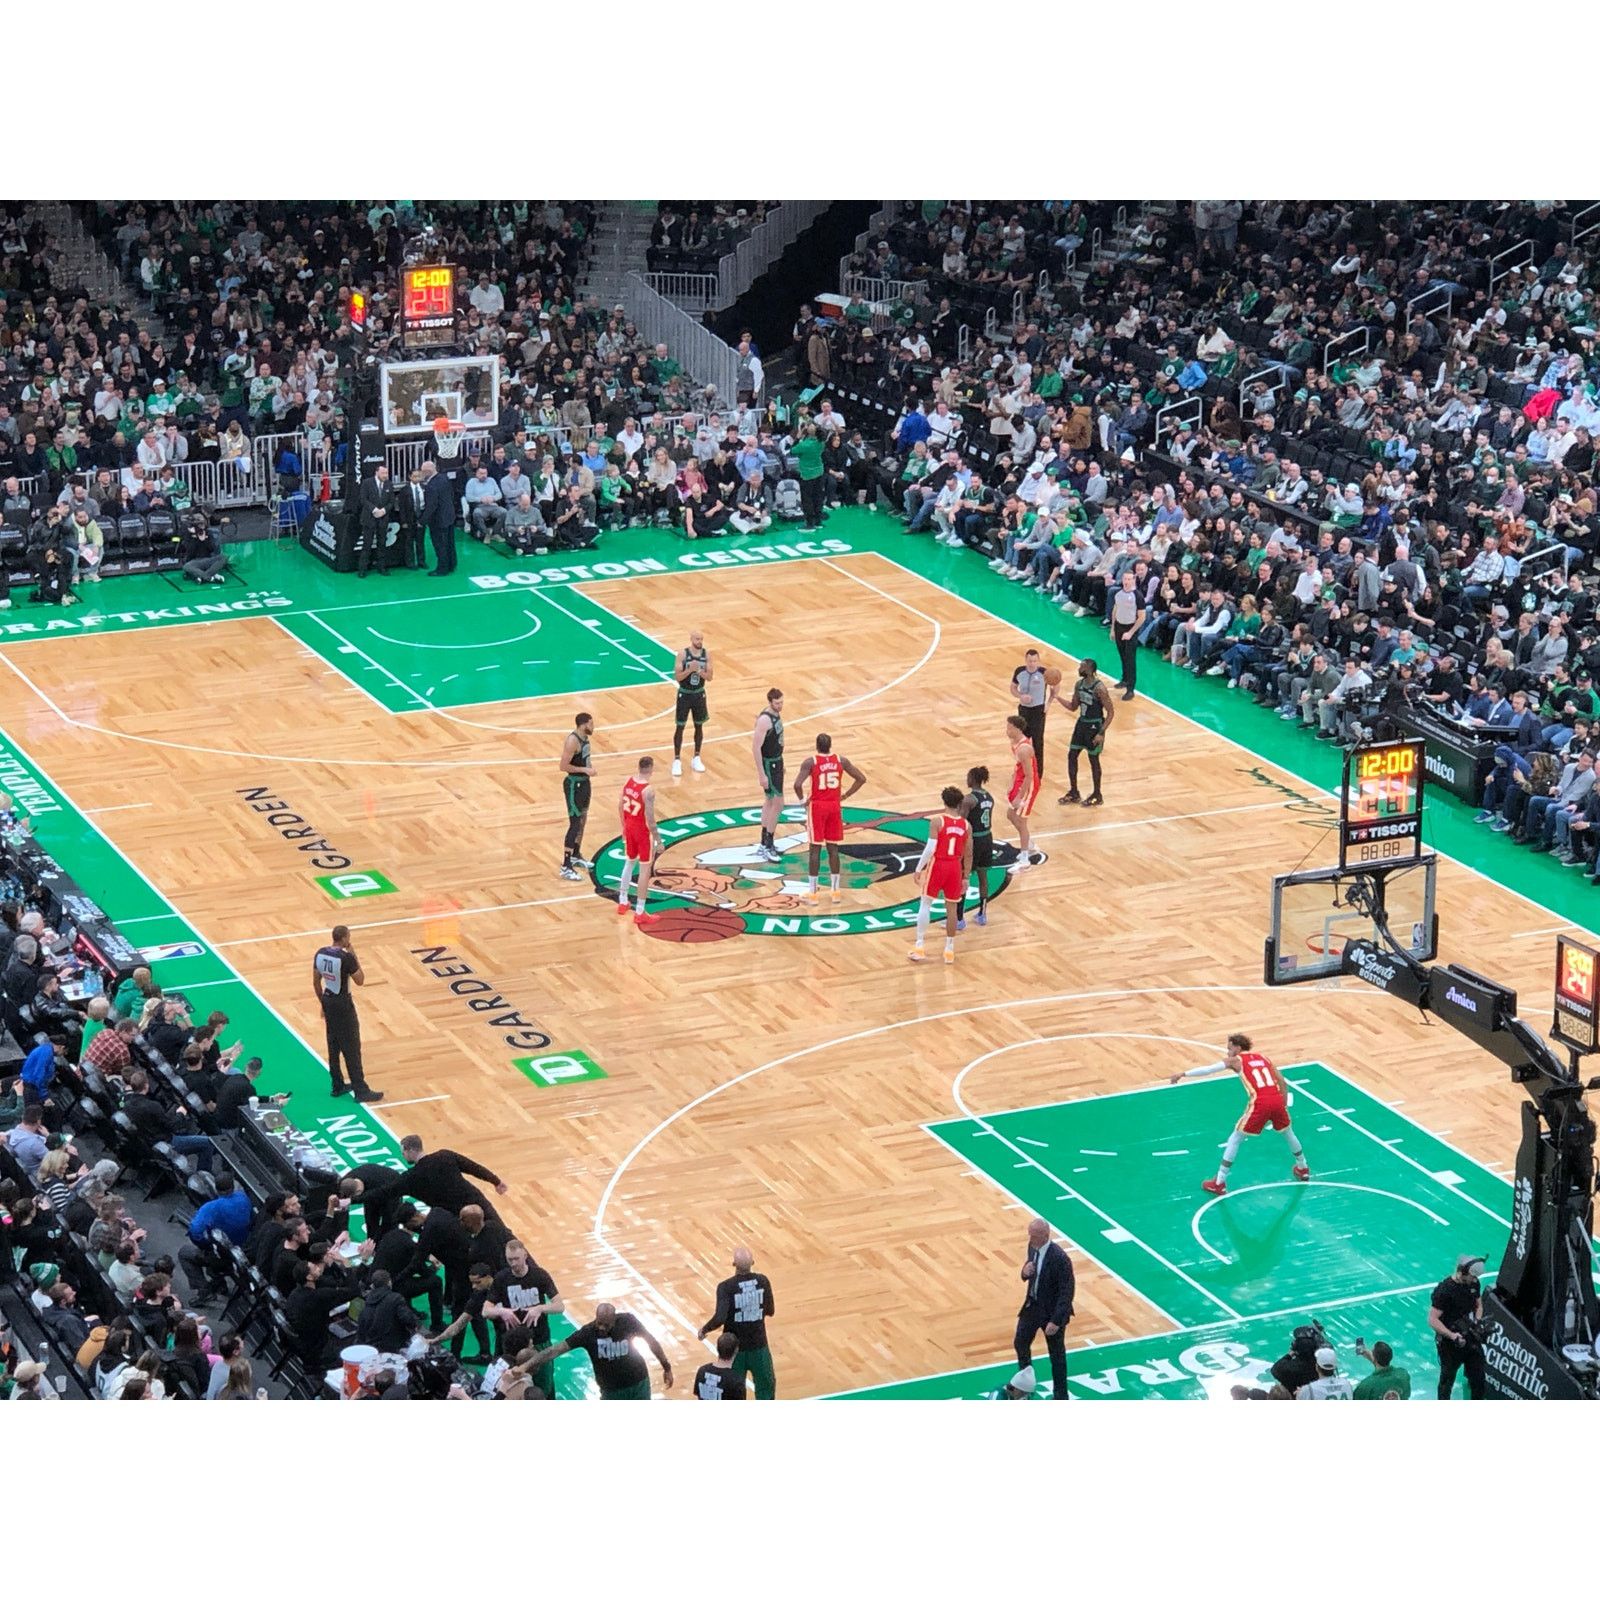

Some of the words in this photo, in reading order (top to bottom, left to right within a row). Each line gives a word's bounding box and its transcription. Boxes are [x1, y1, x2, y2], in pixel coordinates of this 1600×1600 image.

[413, 271, 449, 287] 12:00
[412, 288, 446, 315] 24
[420, 318, 454, 328] TISSOT
[469, 557, 668, 589] BOSTON
[679, 539, 853, 568] CELTICS
[0, 597, 293, 636] RAFTKINGS
[1362, 749, 1414, 777] 12:00
[1424, 754, 1455, 784] mica
[818, 772, 839, 790] 15
[623, 795, 642, 816] 27
[1359, 775, 1408, 817] 24
[235, 786, 352, 870] GARDEN
[980, 809, 990, 828] 4
[1369, 821, 1417, 839] TISSOT
[947, 837, 957, 856] 1
[322, 959, 334, 973] 70
[1359, 968, 1388, 988] BOSTON
[1365, 953, 1396, 980] Sports
[1567, 969, 1587, 995] 24
[410, 946, 552, 1049] GARDEN
[1446, 986, 1477, 1012] Amica
[1251, 1067, 1275, 1088] 11
[1487, 1321, 1538, 1371] Boston
